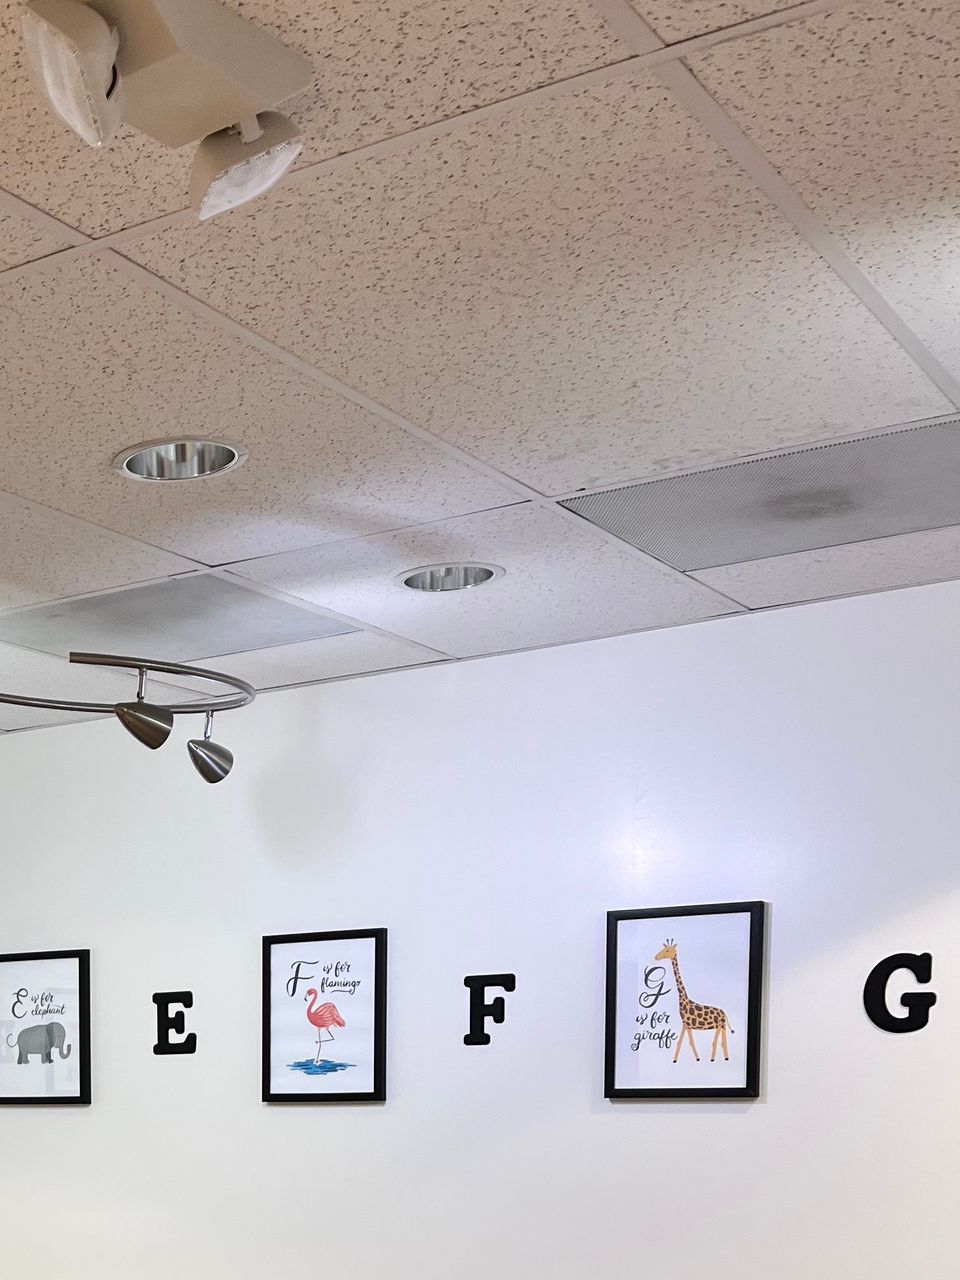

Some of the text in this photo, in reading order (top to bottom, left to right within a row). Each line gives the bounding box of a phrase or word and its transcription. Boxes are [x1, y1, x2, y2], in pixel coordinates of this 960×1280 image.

[286, 960, 352, 998] F is for
[320, 977, 362, 996] flamingo
[638, 965, 672, 1009] G
[863, 952, 937, 1034] G
[11, 987, 54, 1019] E is for
[30, 1003, 67, 1020] elephant
[463, 973, 516, 1046] F
[635, 1010, 671, 1030] is for
[152, 990, 197, 1056] E
[630, 1028, 679, 1052] giraffe
